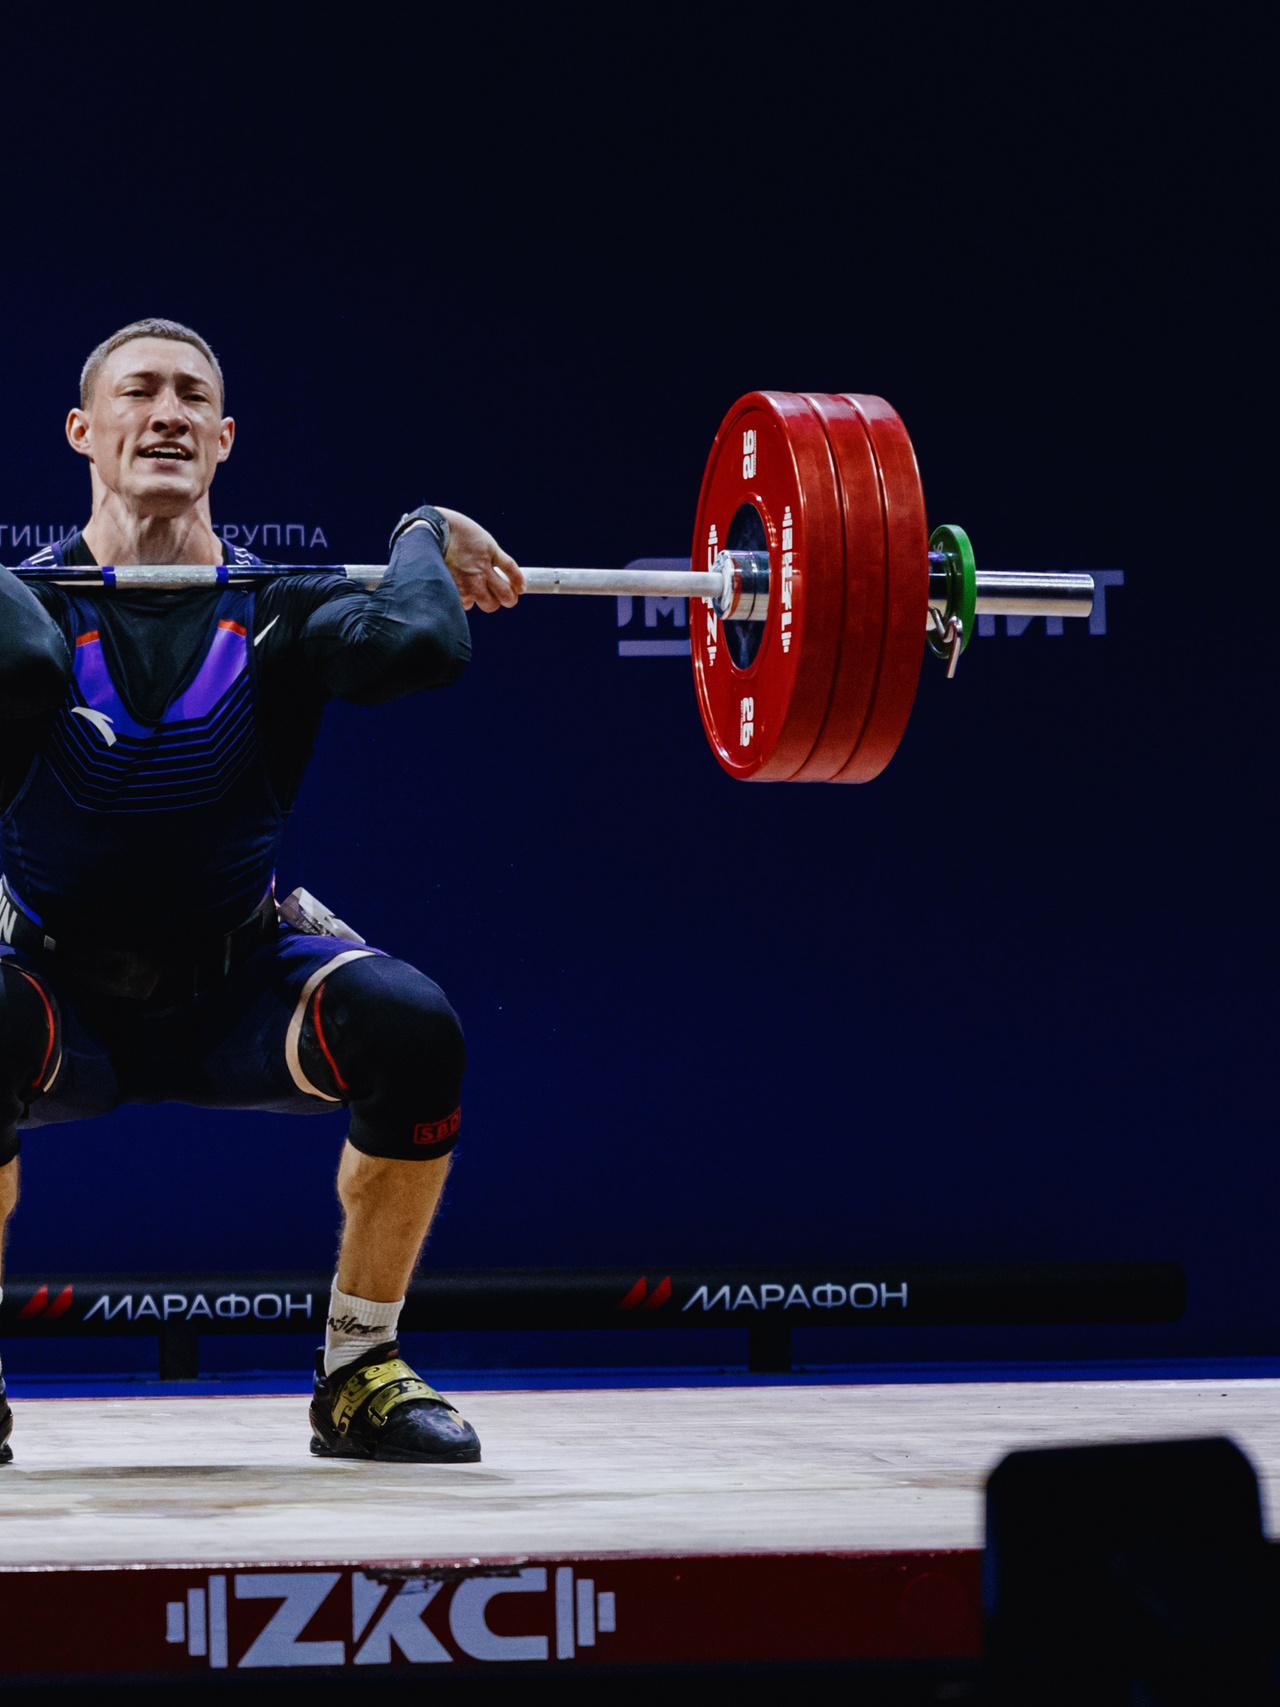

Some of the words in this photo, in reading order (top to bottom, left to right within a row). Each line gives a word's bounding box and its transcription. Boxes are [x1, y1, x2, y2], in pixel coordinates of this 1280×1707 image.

[212, 523, 329, 549] РУППА
[83, 1292, 313, 1321] МАРАФОН
[680, 1281, 909, 1312] МАРАФОН
[234, 1566, 550, 1669] ZKC
